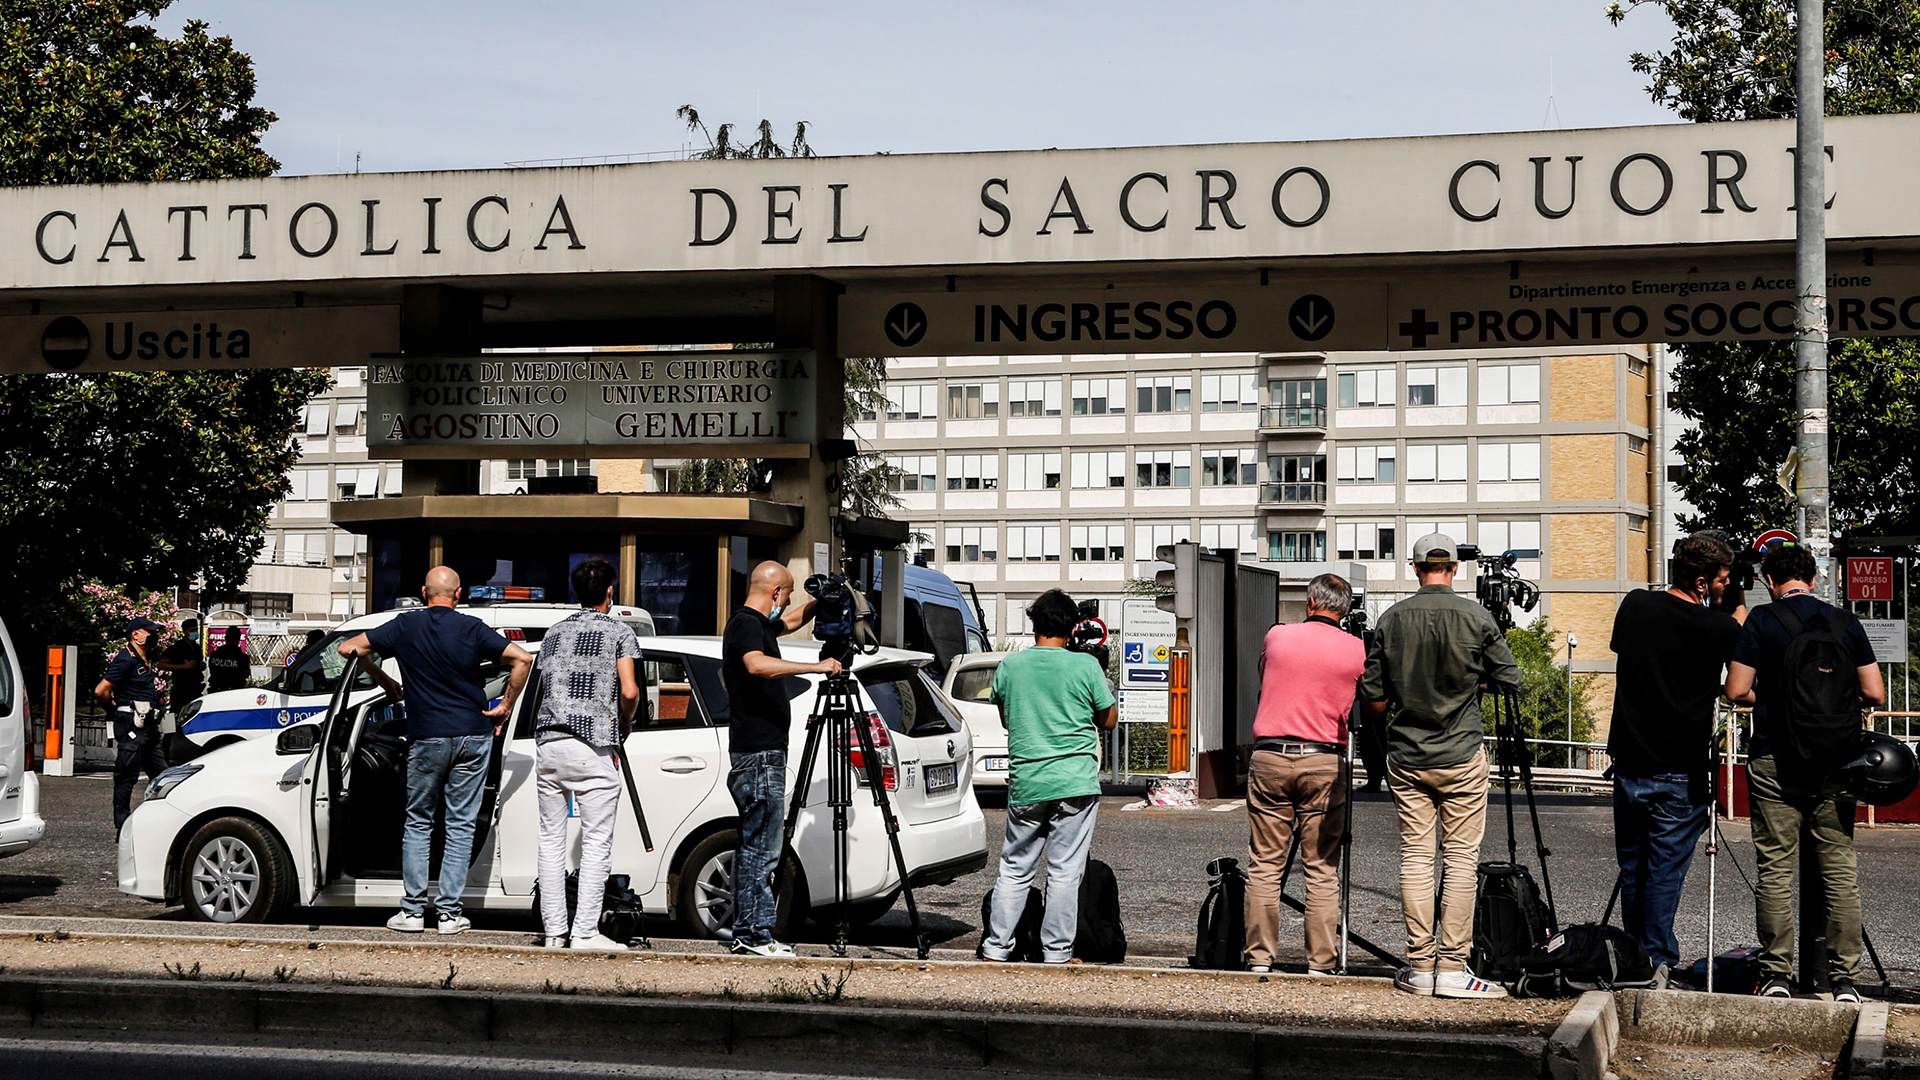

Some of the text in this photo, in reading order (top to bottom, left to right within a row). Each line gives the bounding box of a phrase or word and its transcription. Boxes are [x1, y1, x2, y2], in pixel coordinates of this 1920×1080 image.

[35, 194, 586, 265] CATTOLICA
[688, 183, 869, 247] DEL
[978, 166, 1331, 238] SACRO
[1509, 273, 1872, 302] Dipartimento Emergenza e Accezione
[974, 300, 1237, 342] INGRESSO
[1450, 296, 1920, 343] PRONTO SOCCRSO
[105, 321, 250, 360] Uscita
[480, 361, 504, 382] DI
[512, 360, 630, 382] MEDICINA
[639, 360, 654, 380] E
[666, 359, 809, 380] CHIRURGIA
[408, 384, 771, 406] POLICLINICO UNIVERSITARIO
[1853, 561, 1887, 575] VV.F.
[1852, 576, 1888, 584] INGRESSO
[1862, 584, 1876, 598] 01
[504, 629, 526, 640] TAXI
[211, 657, 238, 668] POLIZIA
